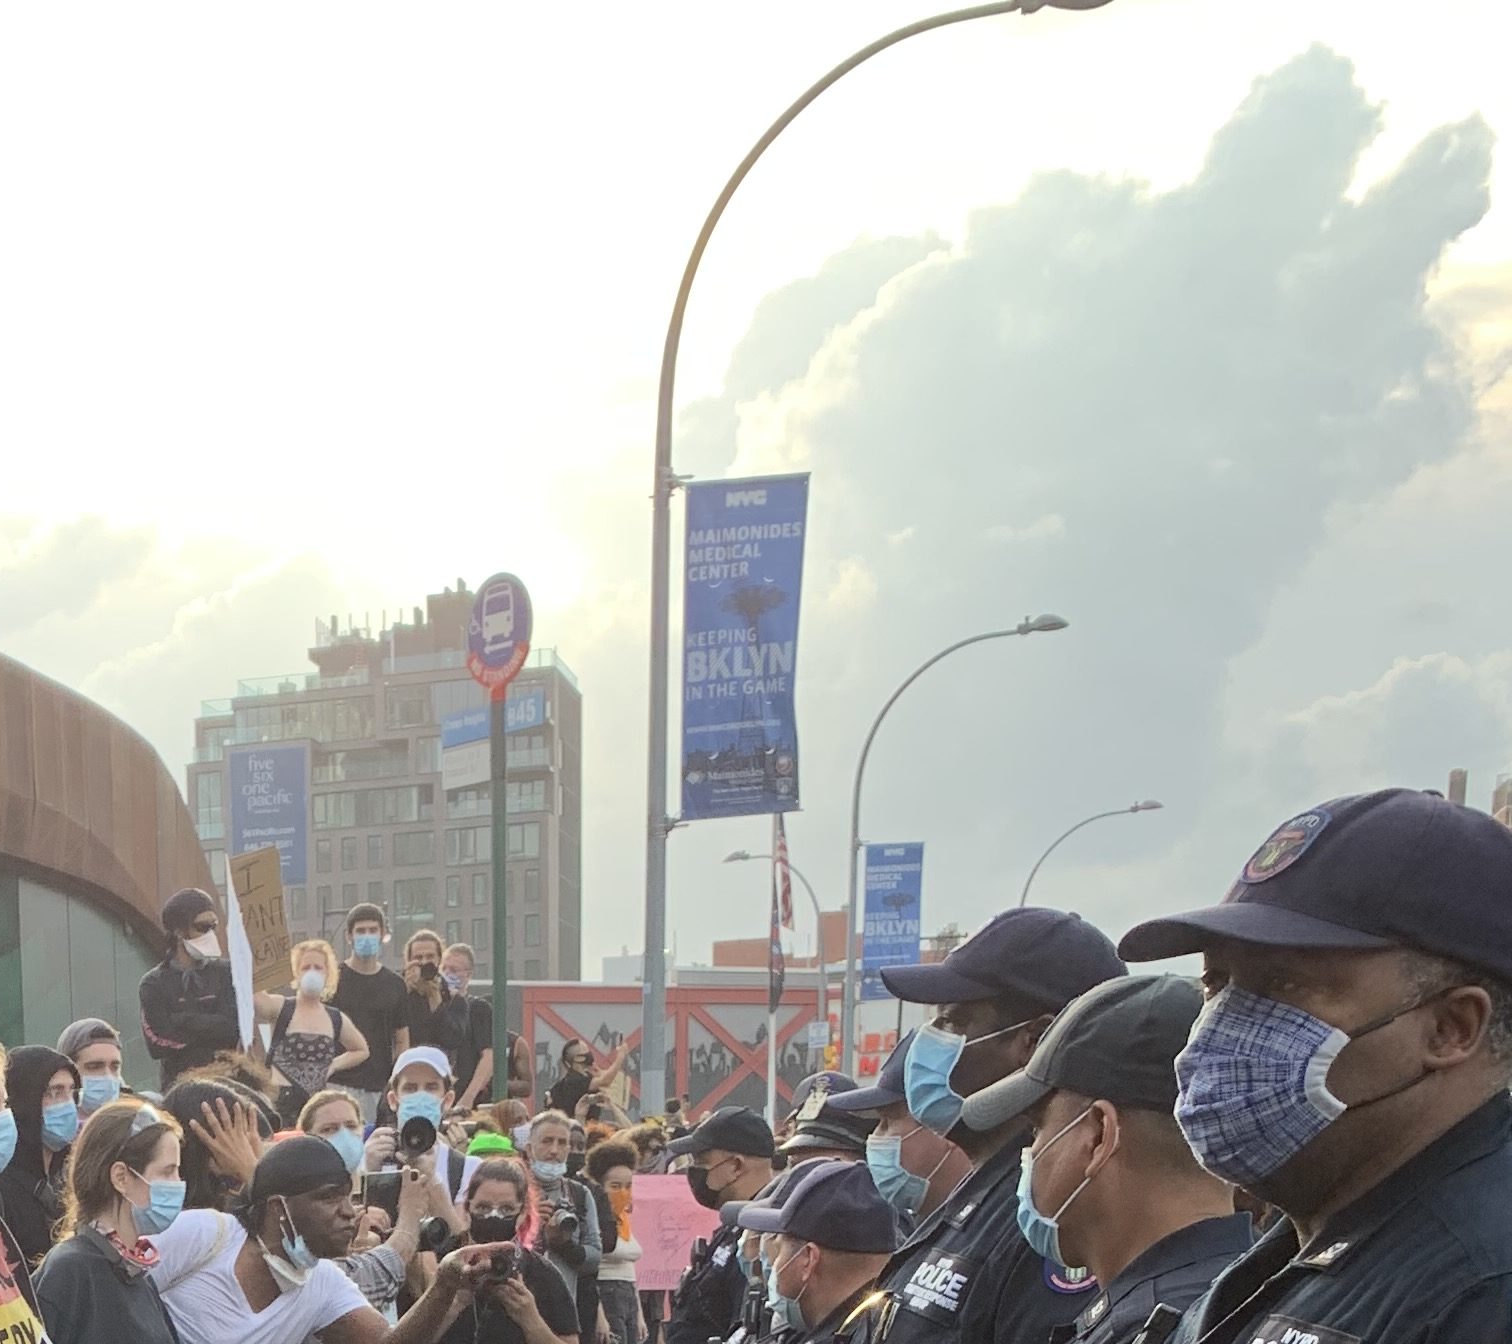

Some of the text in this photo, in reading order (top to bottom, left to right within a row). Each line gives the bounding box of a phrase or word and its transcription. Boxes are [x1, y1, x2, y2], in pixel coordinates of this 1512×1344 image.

[725, 490, 767, 507] NYC
[689, 522, 803, 545] MAIMONIDES
[689, 543, 761, 563] MEDICAL
[689, 562, 749, 581] CENTER
[687, 628, 757, 646] KEEPING
[687, 641, 793, 682] BKLYN
[707, 681, 738, 698] THE
[743, 676, 786, 695] GAME
[249, 754, 274, 771] five
[242, 783, 270, 796] one
[248, 788, 293, 811] pacific
[866, 919, 919, 936] BKLYN
[910, 1261, 968, 1299] POLICE
